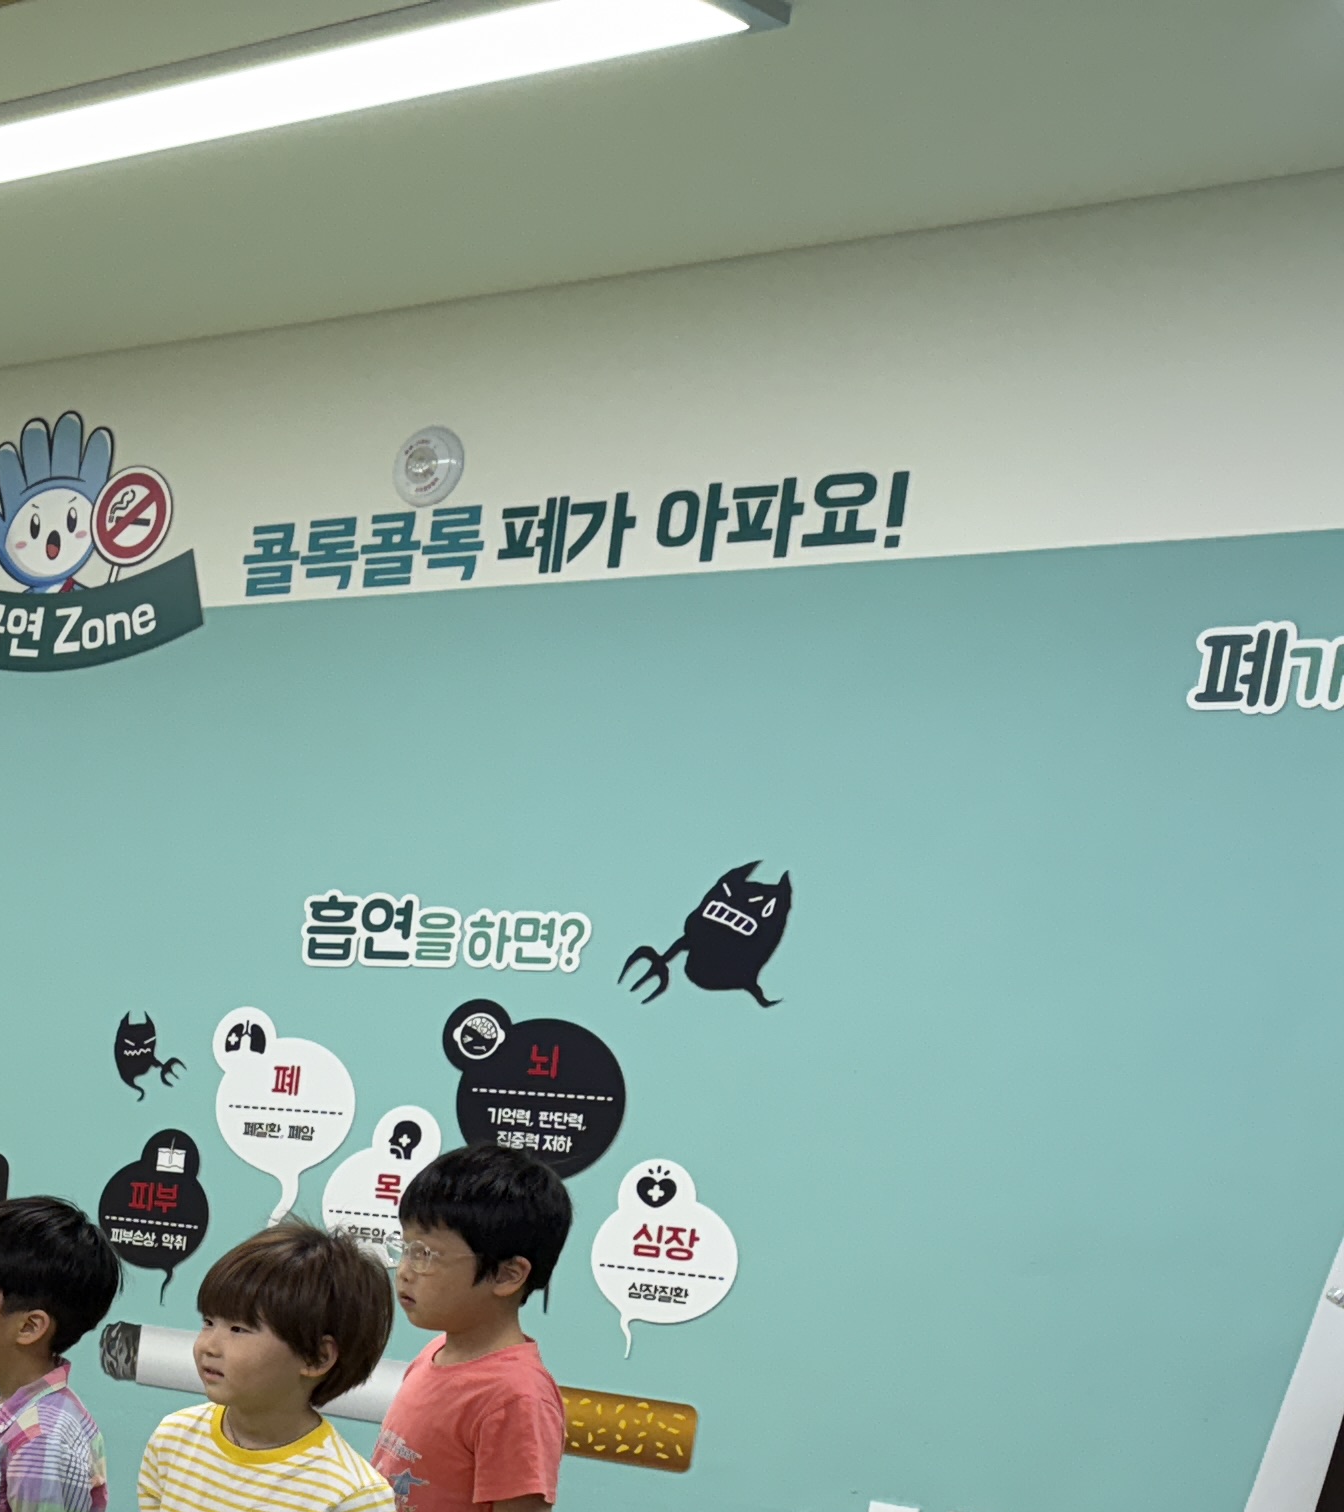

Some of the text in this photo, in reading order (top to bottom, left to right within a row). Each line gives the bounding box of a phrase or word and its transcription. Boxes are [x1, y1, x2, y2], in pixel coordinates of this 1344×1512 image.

[242, 470, 911, 597] 콜록콜록 폐가 아파요!
[52, 602, 157, 655] Zone
[306, 894, 585, 967] 흡연을 하면?
[527, 1044, 560, 1079] 뇌
[271, 1065, 301, 1096] 폐
[243, 1122, 315, 1141] 폐질환, 폐암
[487, 1107, 587, 1131] 기억력, 판단력,
[496, 1130, 573, 1153] 집중력 저하
[128, 1181, 179, 1213] 피부
[374, 1173, 401, 1206] 목
[110, 1228, 187, 1251] 피부손상, 악취
[632, 1223, 700, 1261] 심장
[627, 1282, 690, 1305] 심장질환
